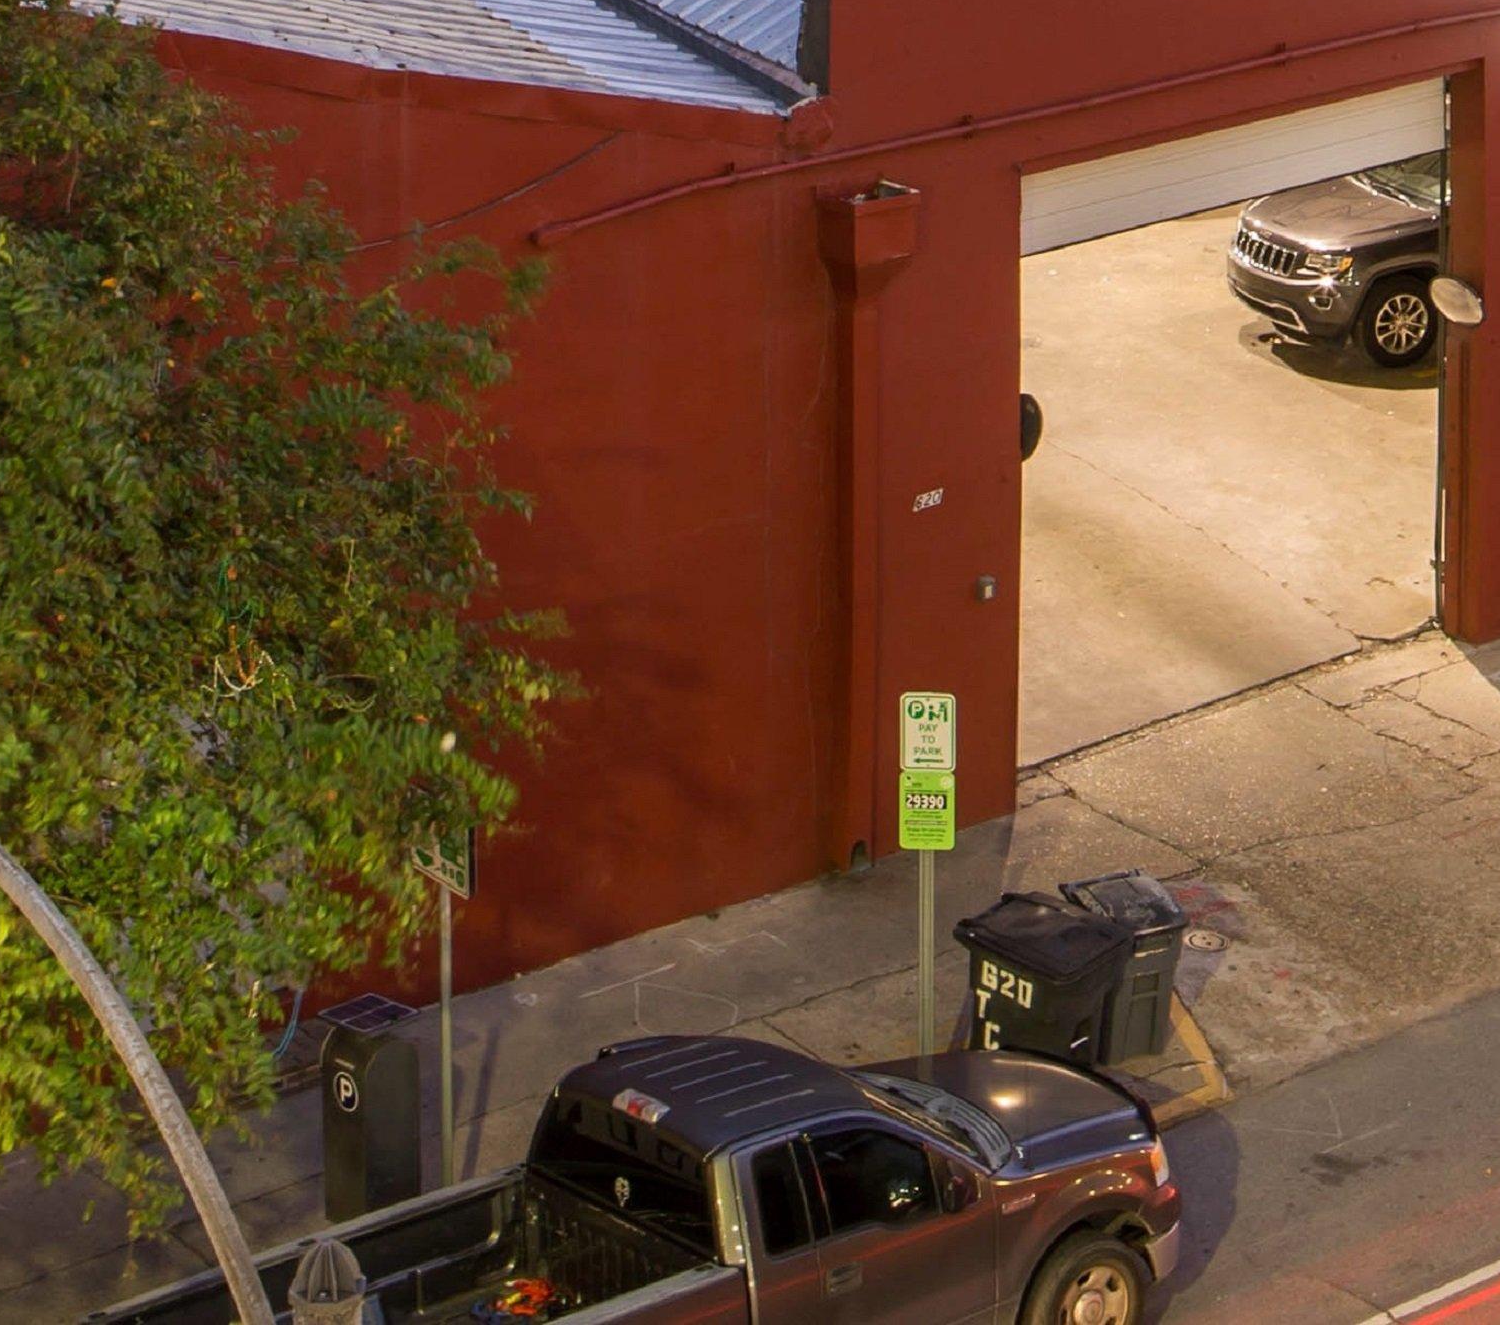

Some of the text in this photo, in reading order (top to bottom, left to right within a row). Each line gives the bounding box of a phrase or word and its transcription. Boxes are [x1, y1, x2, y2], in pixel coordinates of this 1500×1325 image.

[919, 723, 938, 733] PAY
[921, 735, 936, 745] TO
[914, 746, 943, 756] PARK
[906, 795, 945, 810] 29390
